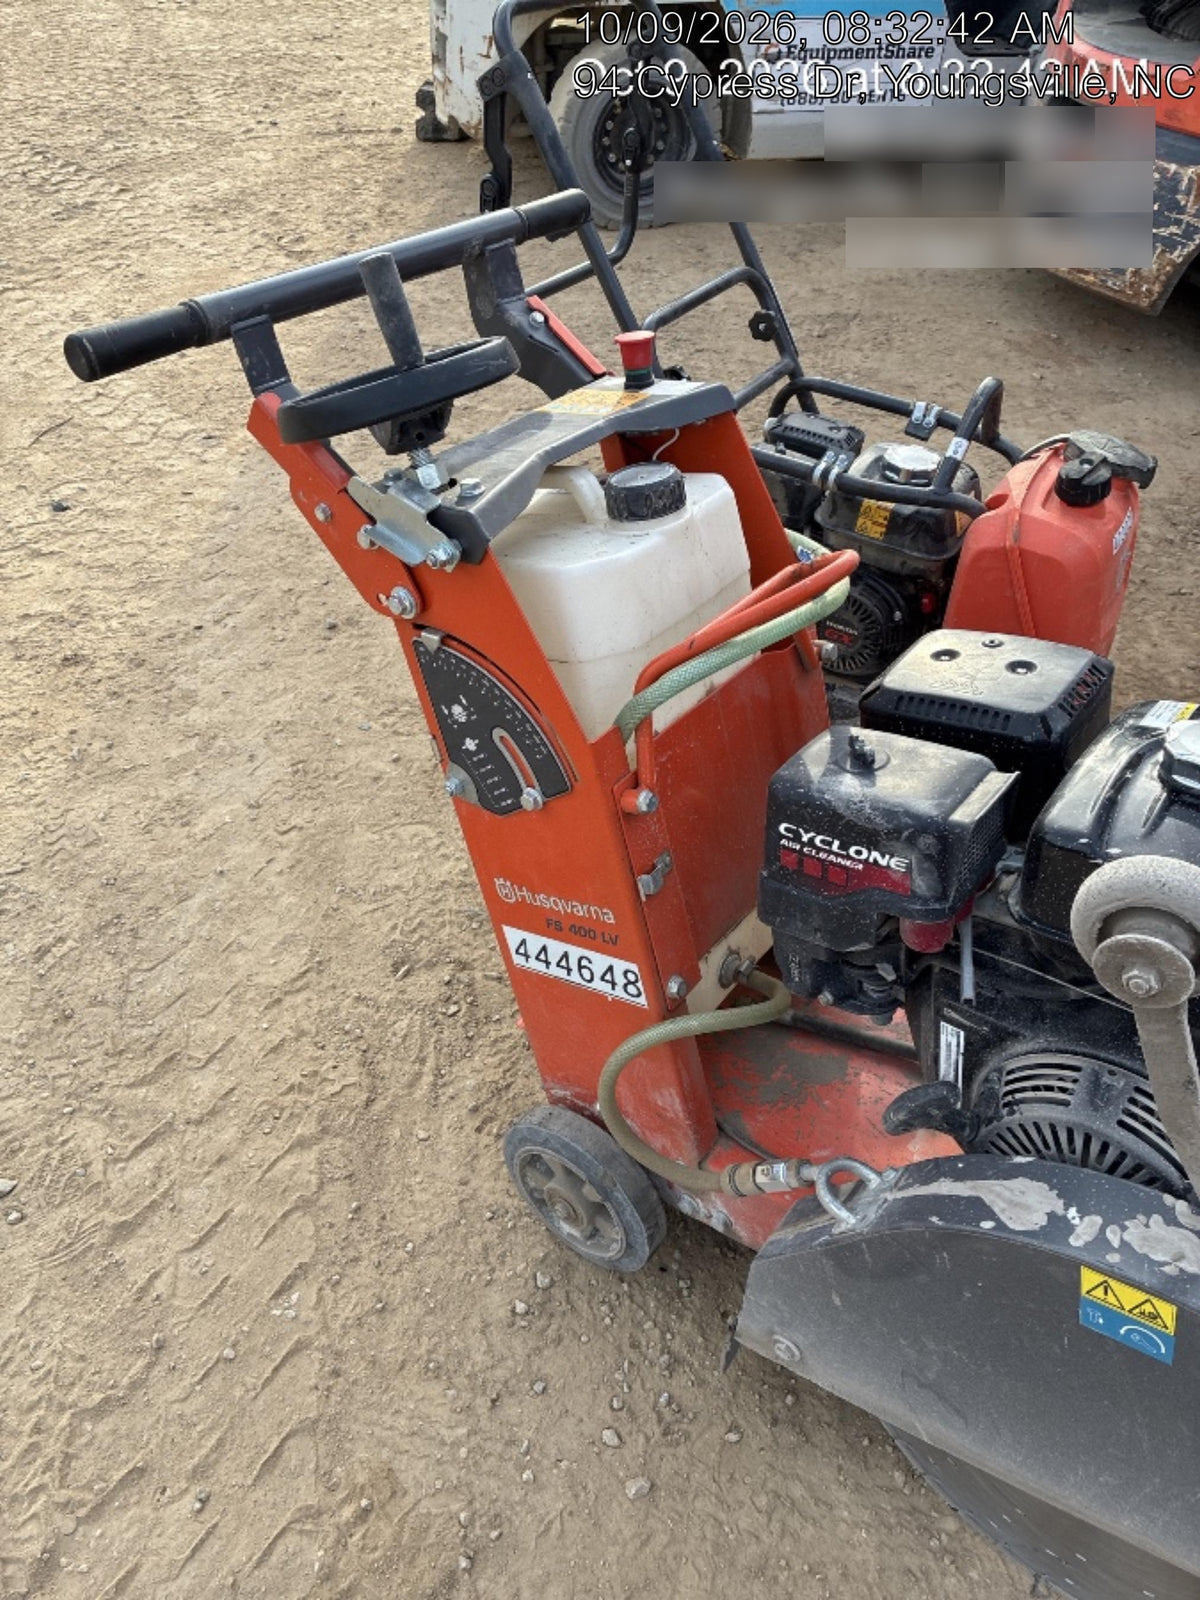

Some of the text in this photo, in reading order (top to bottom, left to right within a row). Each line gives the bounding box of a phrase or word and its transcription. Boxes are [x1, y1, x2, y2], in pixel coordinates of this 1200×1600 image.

[785, 43, 935, 65] EquipmentShare
[778, 822, 910, 873] CYCLONE
[779, 838, 865, 871] AIR CLEANER
[513, 884, 617, 925] Husqvarna
[545, 917, 620, 947] FS 400 LV
[514, 937, 643, 999] 444648
